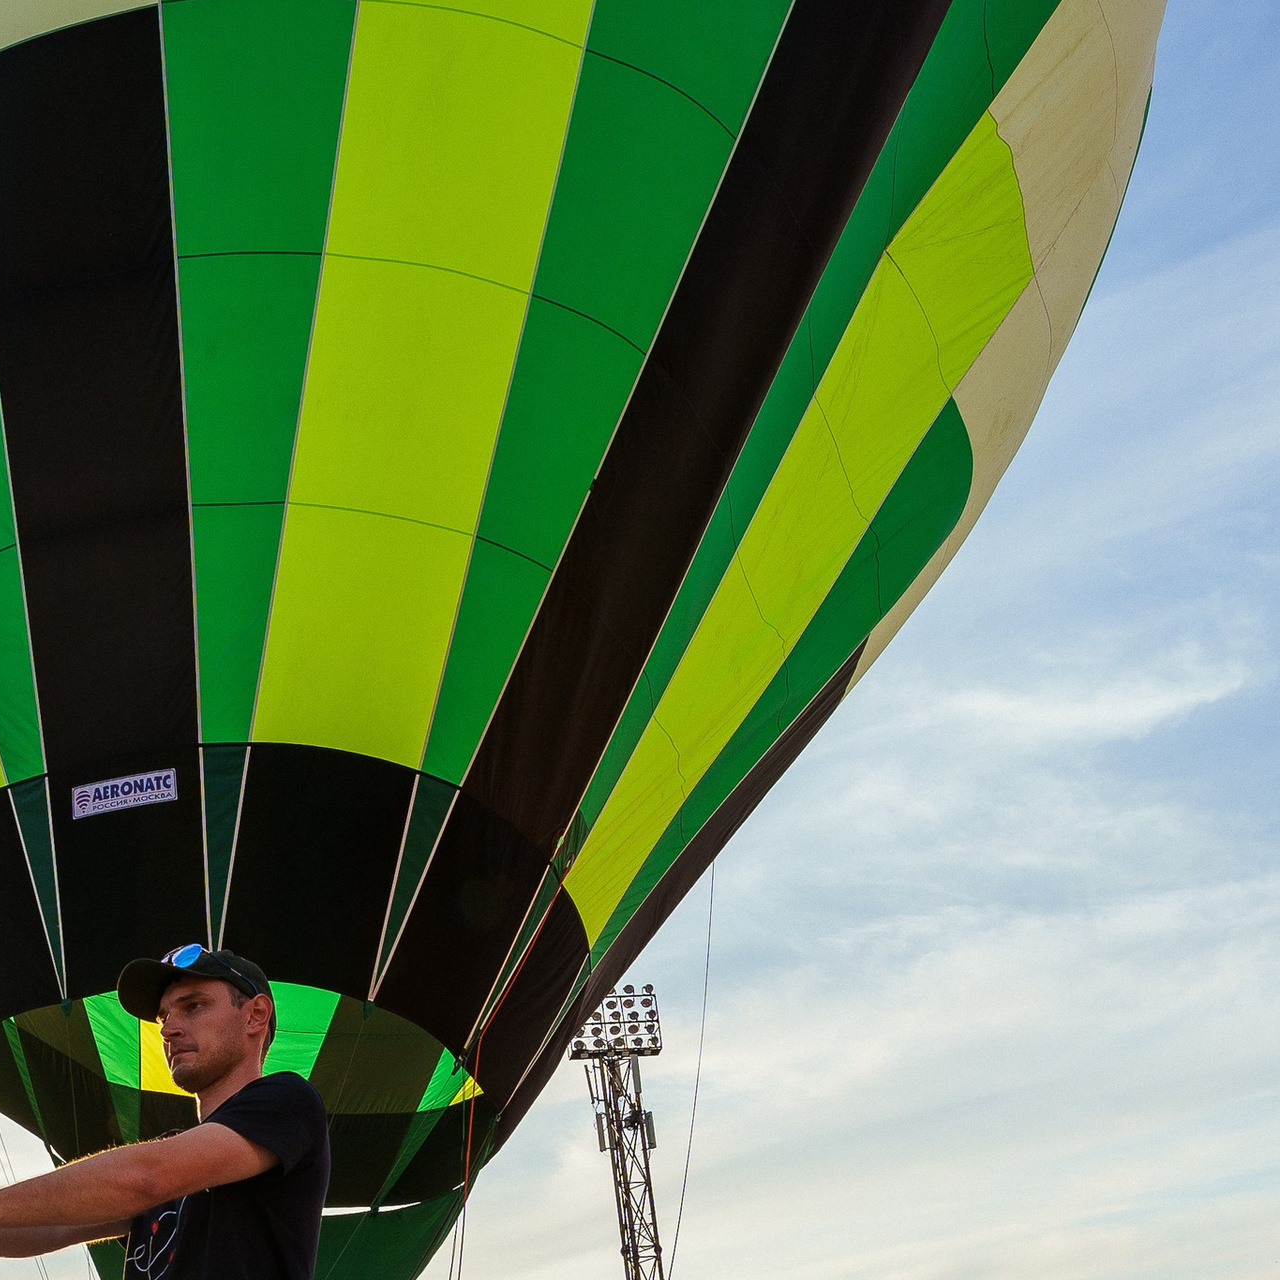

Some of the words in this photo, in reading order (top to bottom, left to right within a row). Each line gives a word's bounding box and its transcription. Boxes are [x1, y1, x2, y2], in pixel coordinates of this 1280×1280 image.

[92, 774, 172, 803] AERONATC
[92, 799, 129, 811] РОССИЯ
[132, 791, 173, 803] МОСКВА
